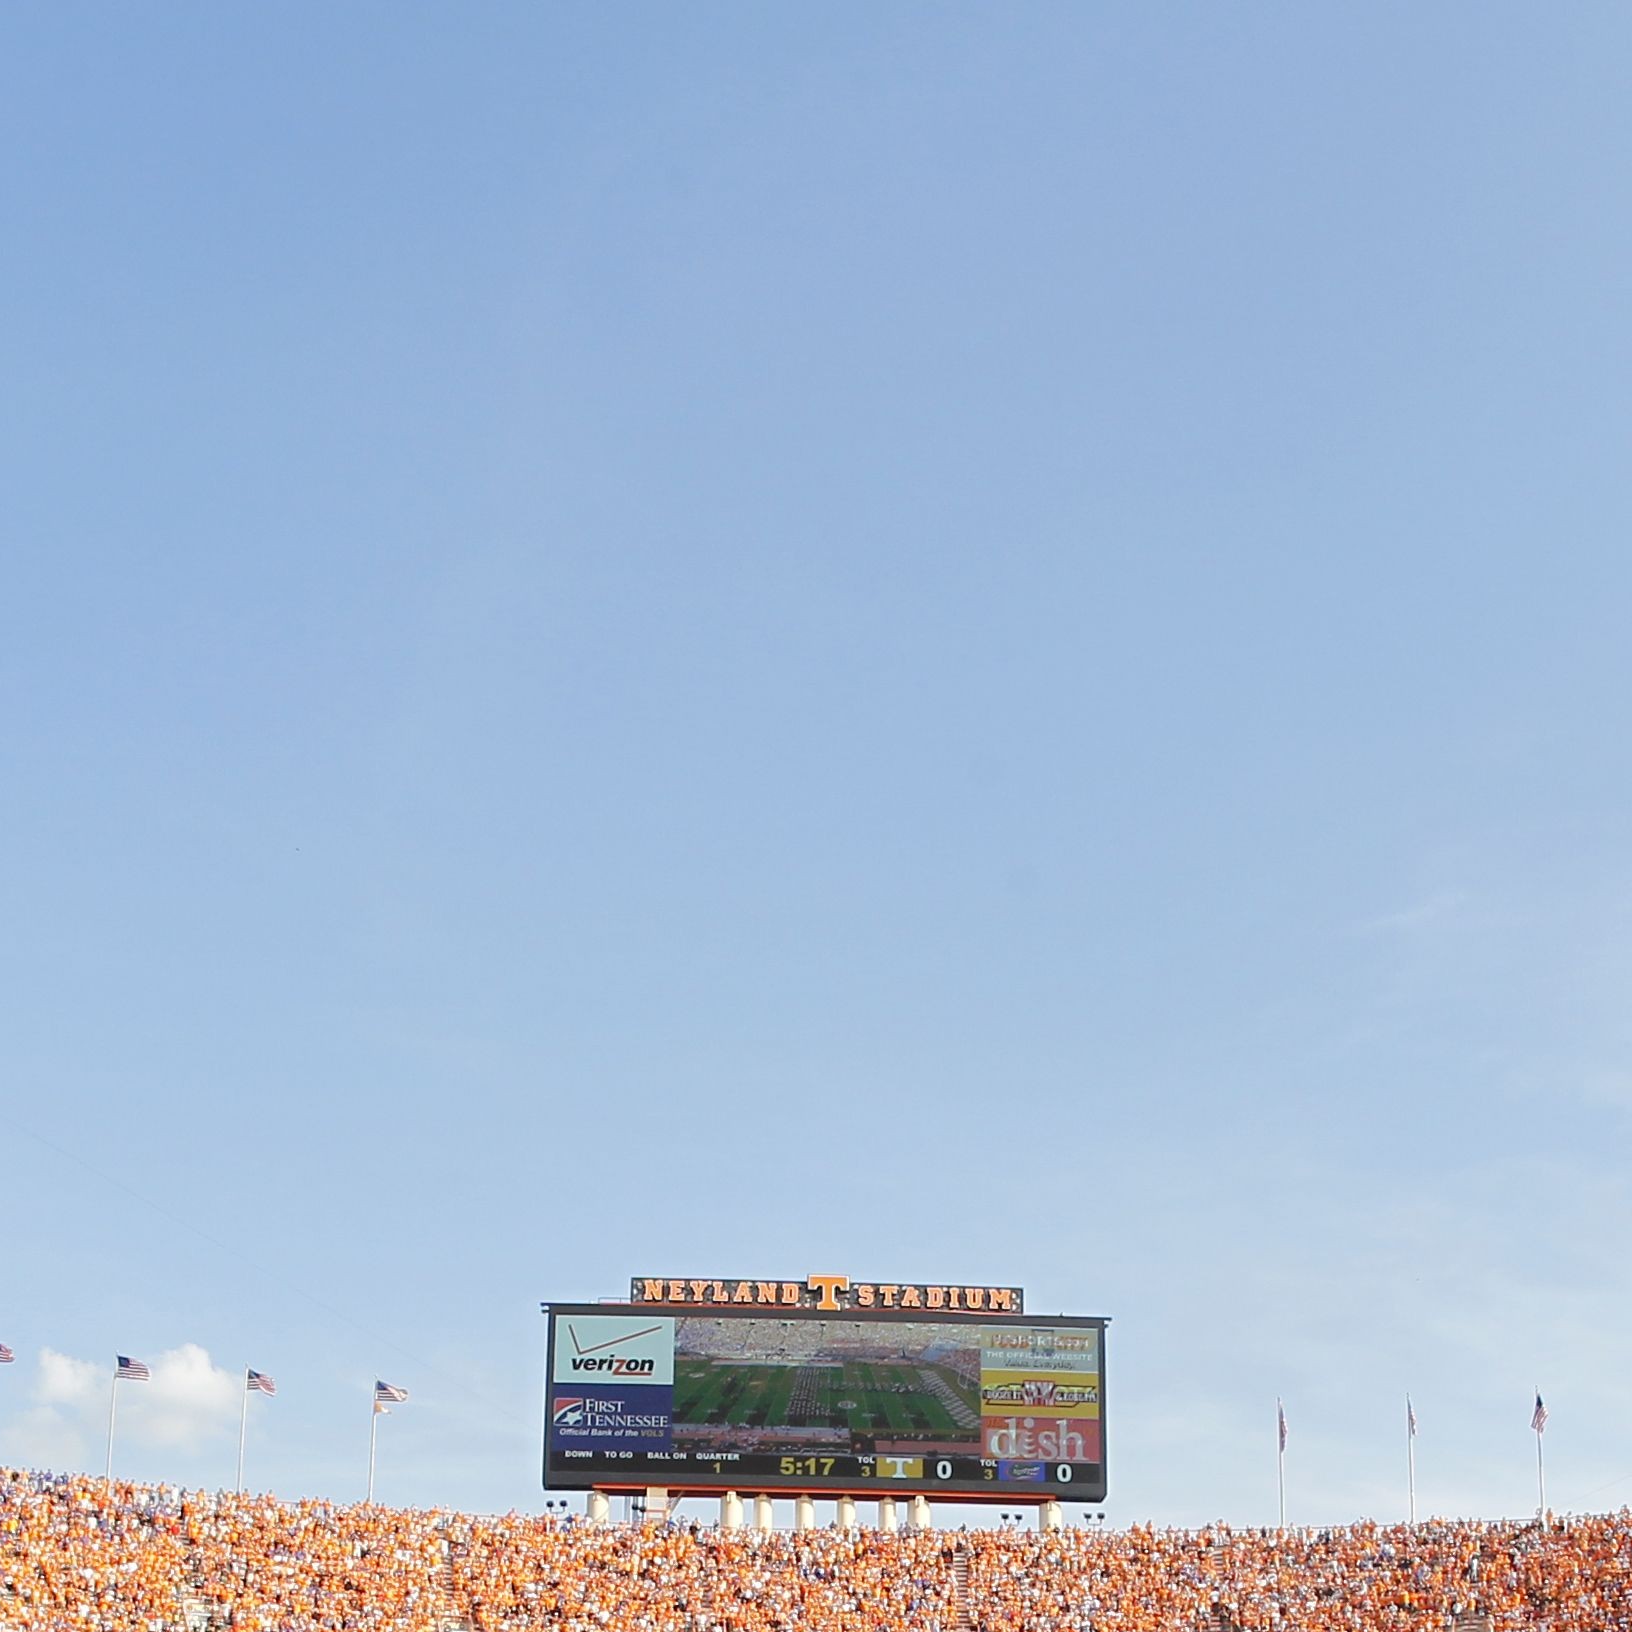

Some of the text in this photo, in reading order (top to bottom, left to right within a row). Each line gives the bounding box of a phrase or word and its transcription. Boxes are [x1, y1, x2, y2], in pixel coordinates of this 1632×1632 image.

[643, 1274, 1012, 1310] NEYLAND T STADIUM
[1007, 1351, 1050, 1359] OFFICIAL
[1053, 1353, 1093, 1361] WEBSITE
[571, 1354, 654, 1376] verizon
[585, 1398, 625, 1413] FIRST
[583, 1412, 668, 1427] TENNESSEE
[559, 1427, 589, 1436] Official
[590, 1428, 612, 1436] Bank
[613, 1428, 624, 1436] of
[625, 1429, 639, 1437] the
[989, 1417, 1090, 1460] dish
[564, 1450, 593, 1458] DOWN
[604, 1450, 633, 1459] TO GO
[647, 1451, 687, 1460] BALL ON
[695, 1452, 740, 1461] QUARTER
[857, 1456, 875, 1464] TOL
[980, 1459, 997, 1467] TOL
[713, 1463, 721, 1474] 1
[780, 1457, 835, 1475] 5:17
[861, 1466, 871, 1477] 3
[886, 1457, 913, 1478] T
[936, 1460, 953, 1479] 0
[984, 1469, 994, 1480] 3
[1056, 1463, 1073, 1483] 0
